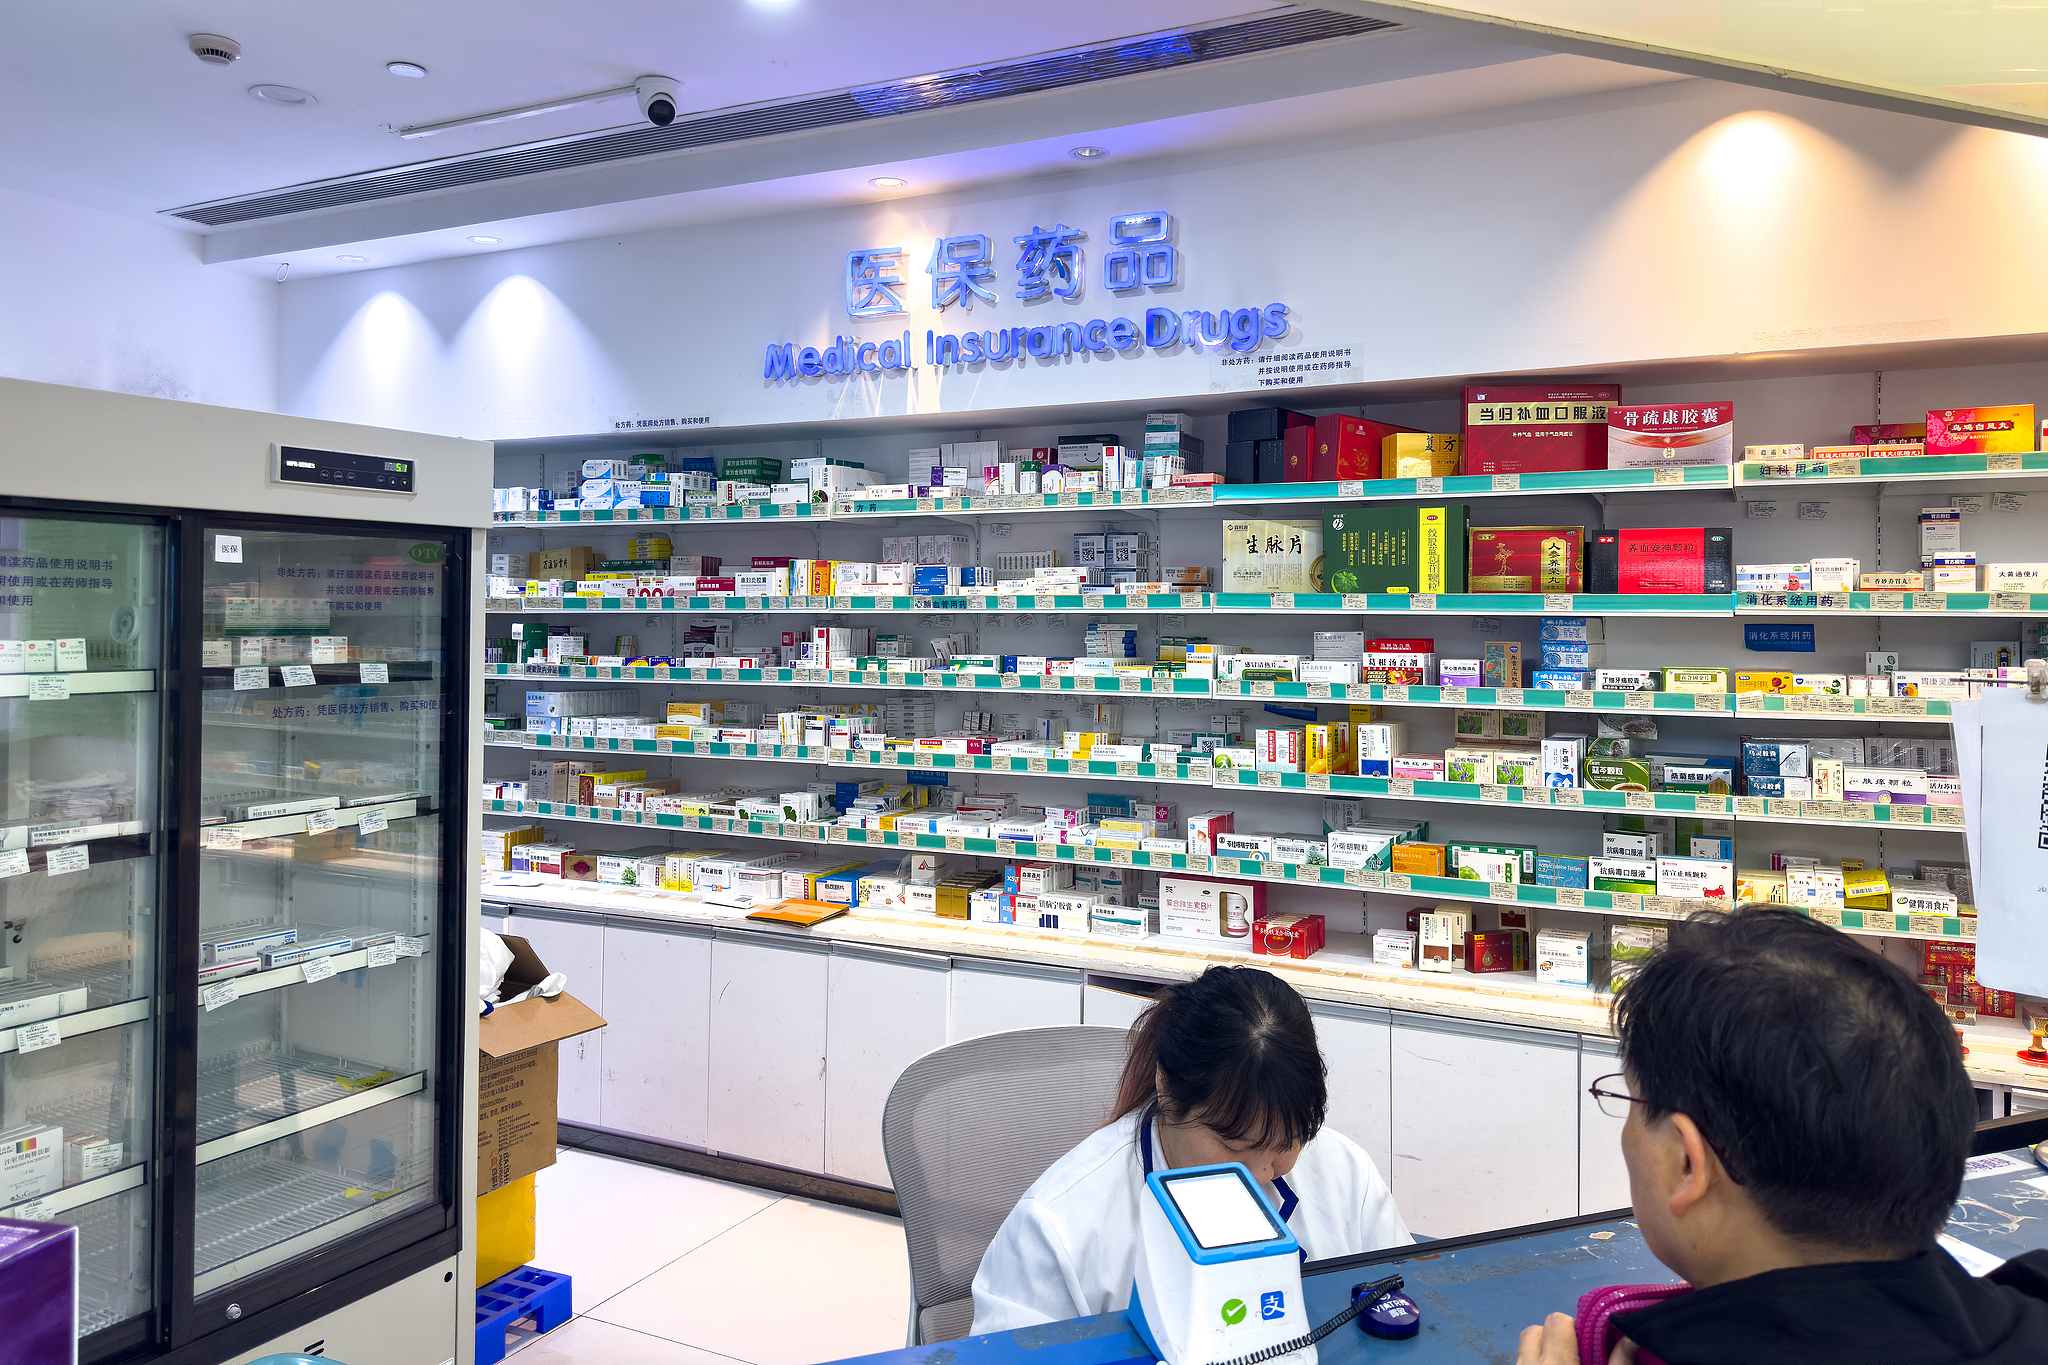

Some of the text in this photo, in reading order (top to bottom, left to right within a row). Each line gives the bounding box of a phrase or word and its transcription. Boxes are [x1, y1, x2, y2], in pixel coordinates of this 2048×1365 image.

[845, 210, 1178, 317] 医保药品
[764, 302, 1291, 381] Medical Insurance Drugs
[1257, 361, 1351, 375] 并按说明使用或在药师指导
[1257, 376, 1304, 387] 下购买和使用
[1480, 406, 1606, 421] 当归补血口服液
[1623, 407, 1719, 427] 骨疏康胶囊
[1951, 421, 2010, 432] 乌鸡白凤丸
[1759, 461, 1824, 476] 妇科用药
[844, 503, 877, 513] 处方药
[221, 545, 239, 554] 医保
[1246, 534, 1302, 555] 生脉片
[1628, 543, 1695, 553] 养血安神颗粒
[1548, 542, 1562, 584] 人参养荣丸
[326, 585, 435, 597] 并按说明使用或在药师指导
[327, 601, 382, 611] 下购买和使用
[914, 600, 967, 609] 心脑血管用药
[1746, 594, 1834, 607] 消化系统用药
[1749, 631, 1811, 640] 消化系统用药
[1368, 658, 1418, 667] 葛根汤合剂
[1671, 773, 1713, 781] 桑菊感冒片
[1862, 778, 1913, 787] 肤痒颗粒
[1226, 841, 1260, 849] 苓桂咳喘宁胶囊
[1331, 842, 1369, 852] 小柴胡颗粒
[1606, 846, 1643, 857] 抗病毒口服液
[1600, 867, 1646, 878] 抗病毒口服液
[1661, 869, 1708, 879] 清宣止咳颗粒
[1039, 899, 1072, 911] 镇脑宁胶囊
[1166, 899, 1213, 911] 复合维生素B片
[1908, 899, 1949, 912] 健胃消食片
[1372, 1299, 1410, 1314] VIATRIS
